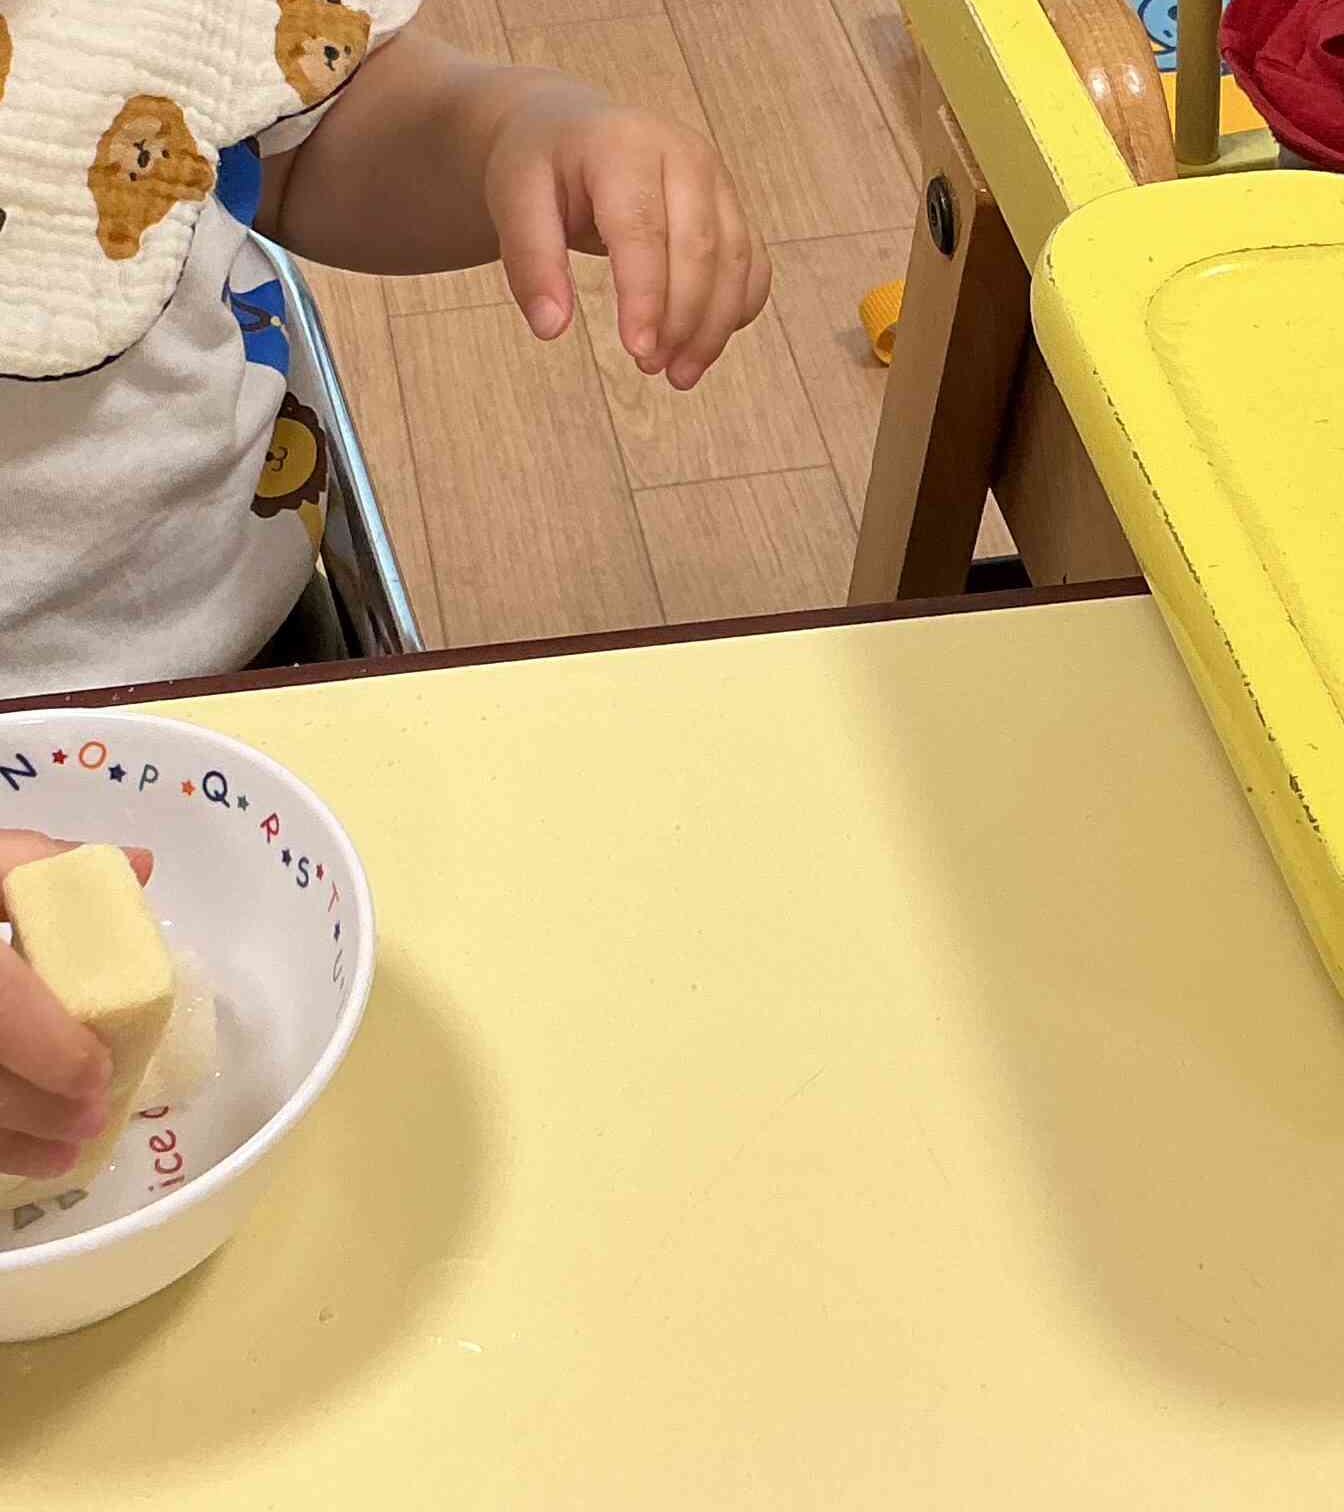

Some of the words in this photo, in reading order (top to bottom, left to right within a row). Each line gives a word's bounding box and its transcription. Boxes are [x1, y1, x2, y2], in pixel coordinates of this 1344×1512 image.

[78, 740, 107, 770] O
[139, 764, 158, 791] P
[202, 770, 230, 808] Q
[260, 813, 280, 843] R
[296, 857, 310, 887] S
